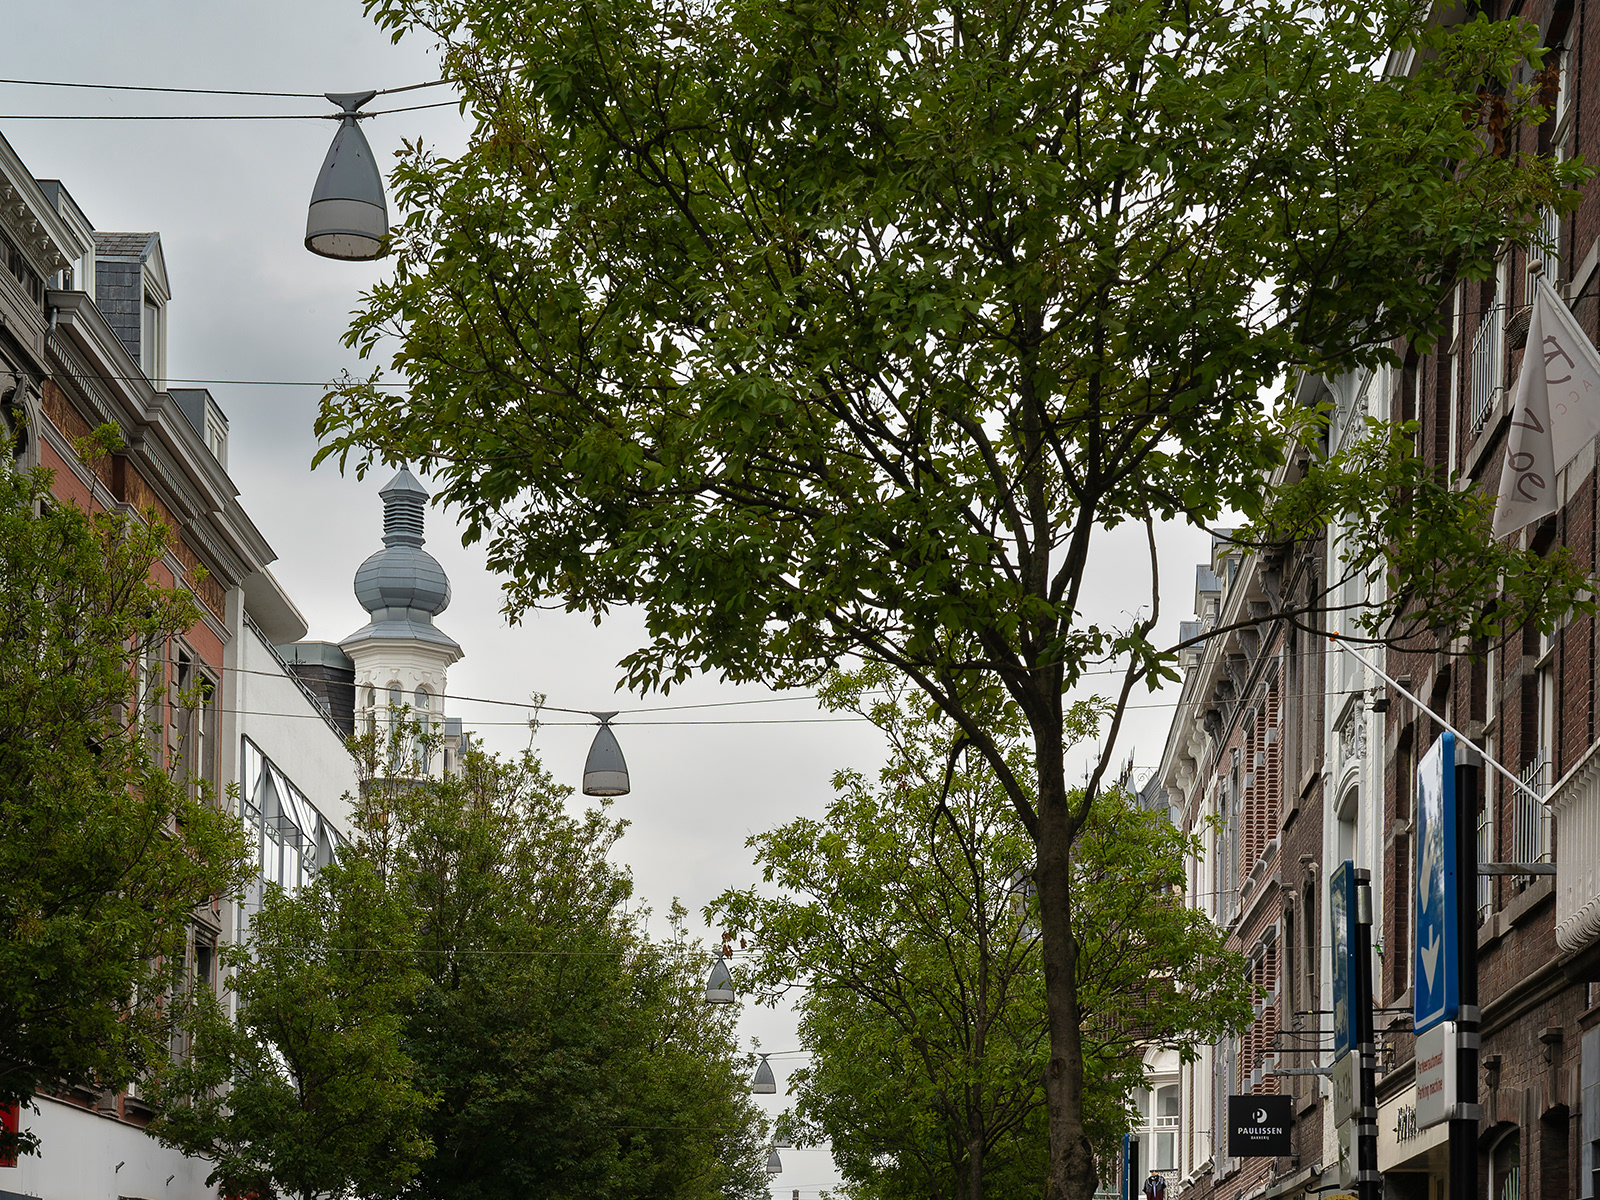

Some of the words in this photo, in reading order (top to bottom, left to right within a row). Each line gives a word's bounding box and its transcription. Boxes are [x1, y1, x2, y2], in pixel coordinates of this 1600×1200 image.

[1417, 1086, 1429, 1101] Parking
[1430, 1079, 1443, 1095] machine
[1237, 1127, 1283, 1135] PAULISSEN
